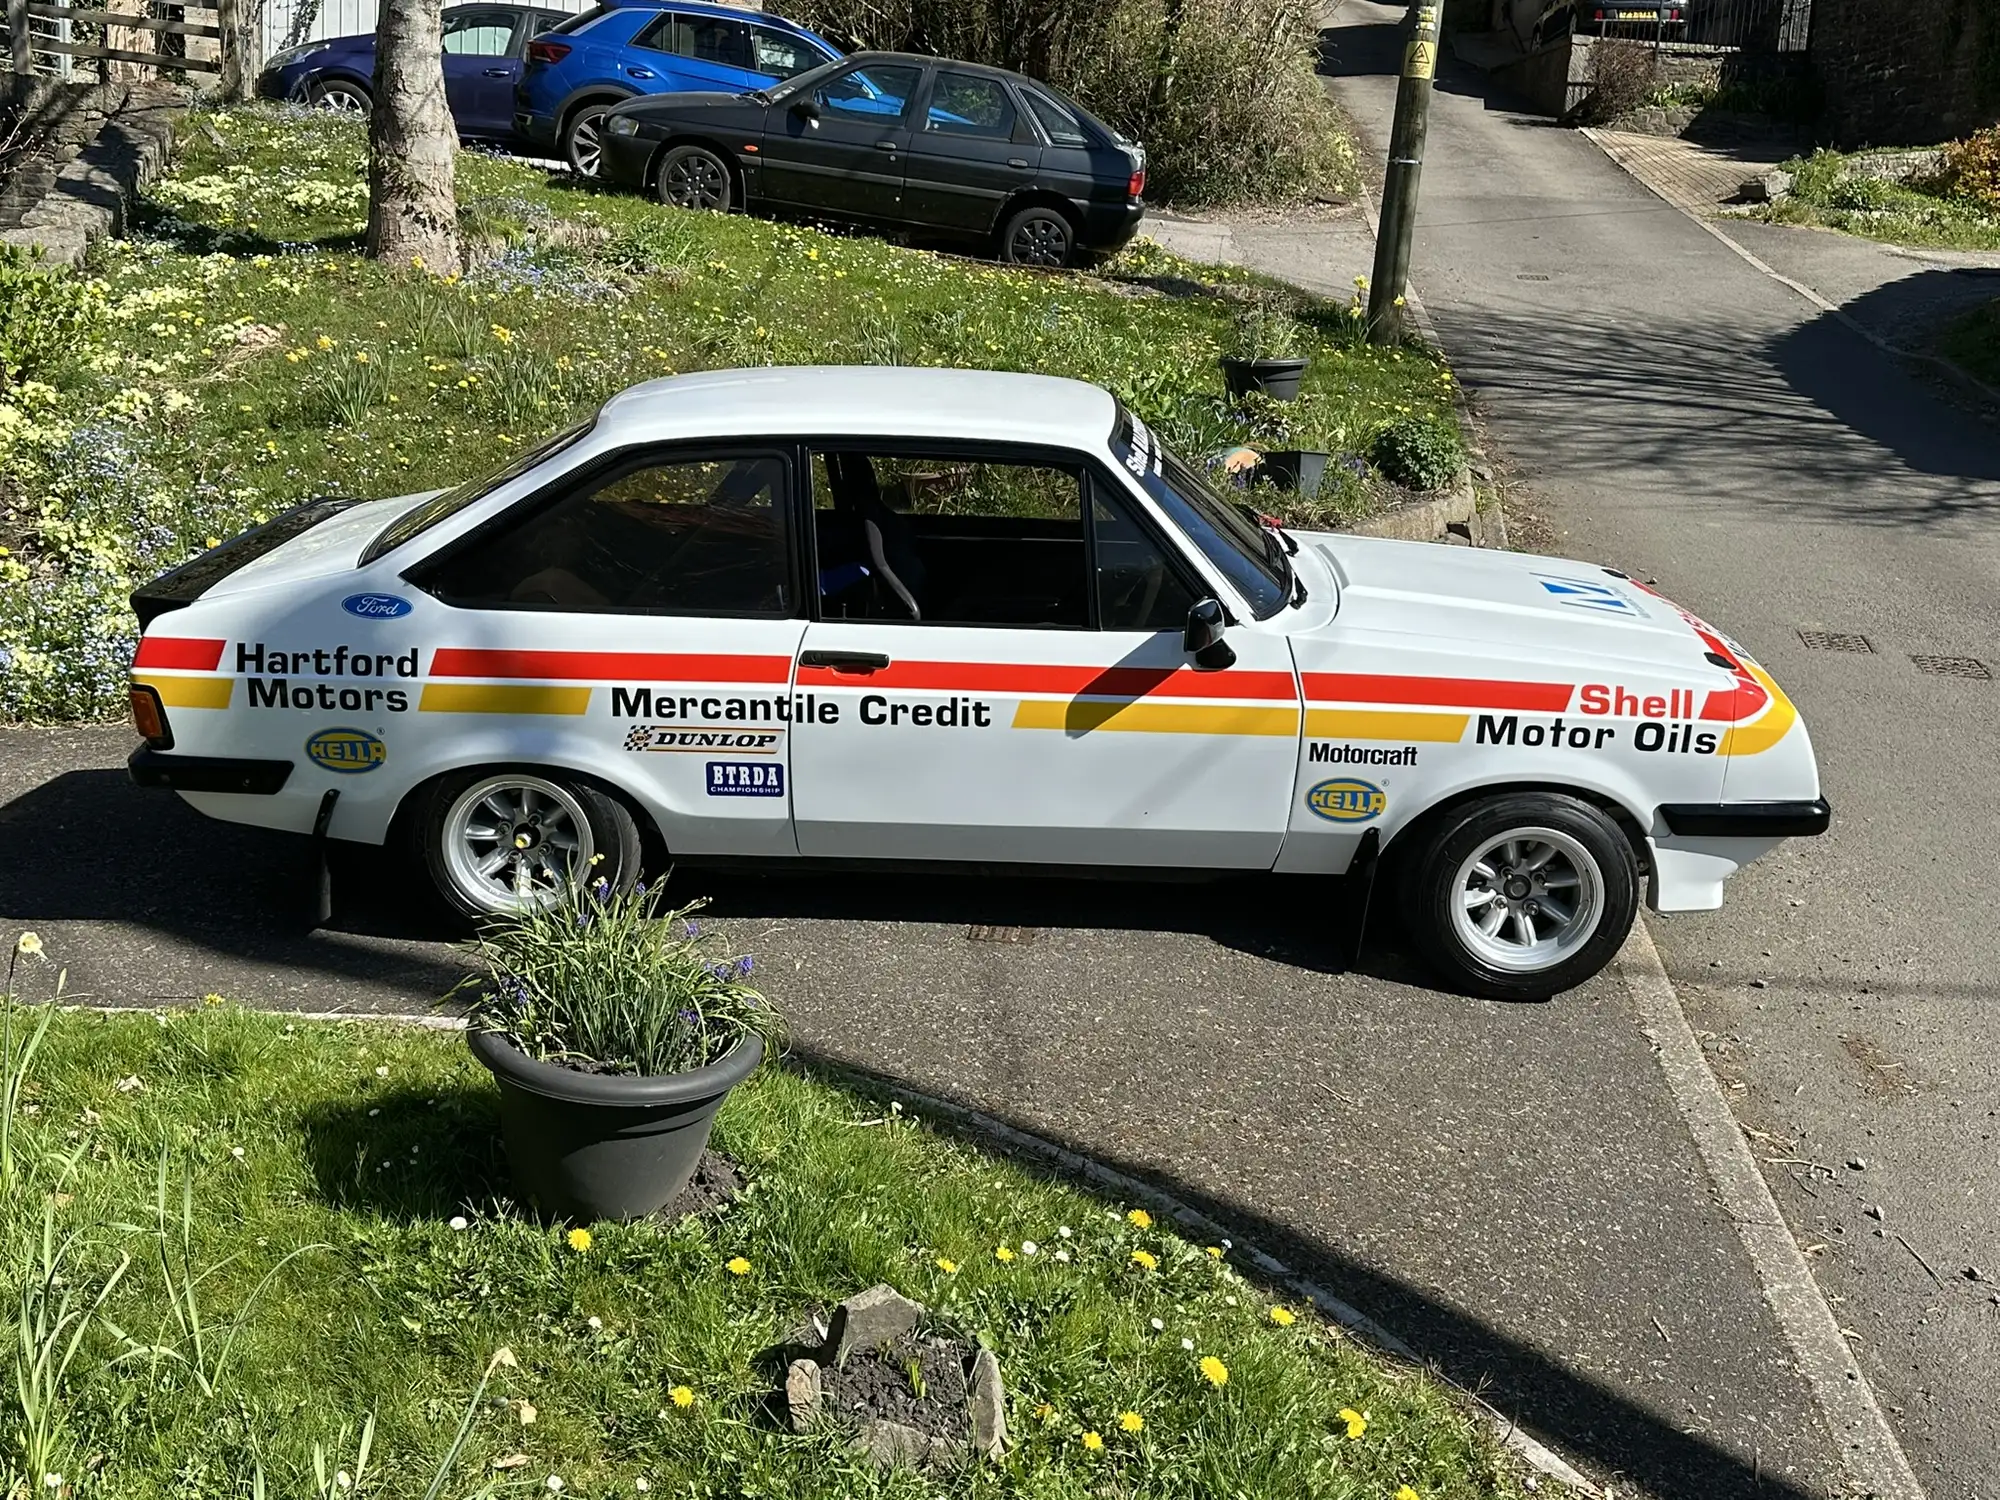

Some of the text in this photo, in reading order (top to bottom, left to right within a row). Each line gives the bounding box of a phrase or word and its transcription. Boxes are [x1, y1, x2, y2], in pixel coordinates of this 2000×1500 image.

[356, 596, 399, 616] Ford
[235, 643, 419, 678] Hartford
[246, 677, 409, 712] Motors
[611, 687, 991, 728] Mercantile Credit
[1579, 684, 1694, 720] Shell
[654, 732, 777, 748] DUNLOP
[1475, 714, 1718, 755] Motor Oils
[309, 739, 386, 765] HELLA
[1308, 742, 1418, 766] Motorcraft
[712, 765, 778, 786] BTRDA
[710, 785, 781, 794] CHAMPIONSHIP
[1310, 790, 1387, 816] HELLA
